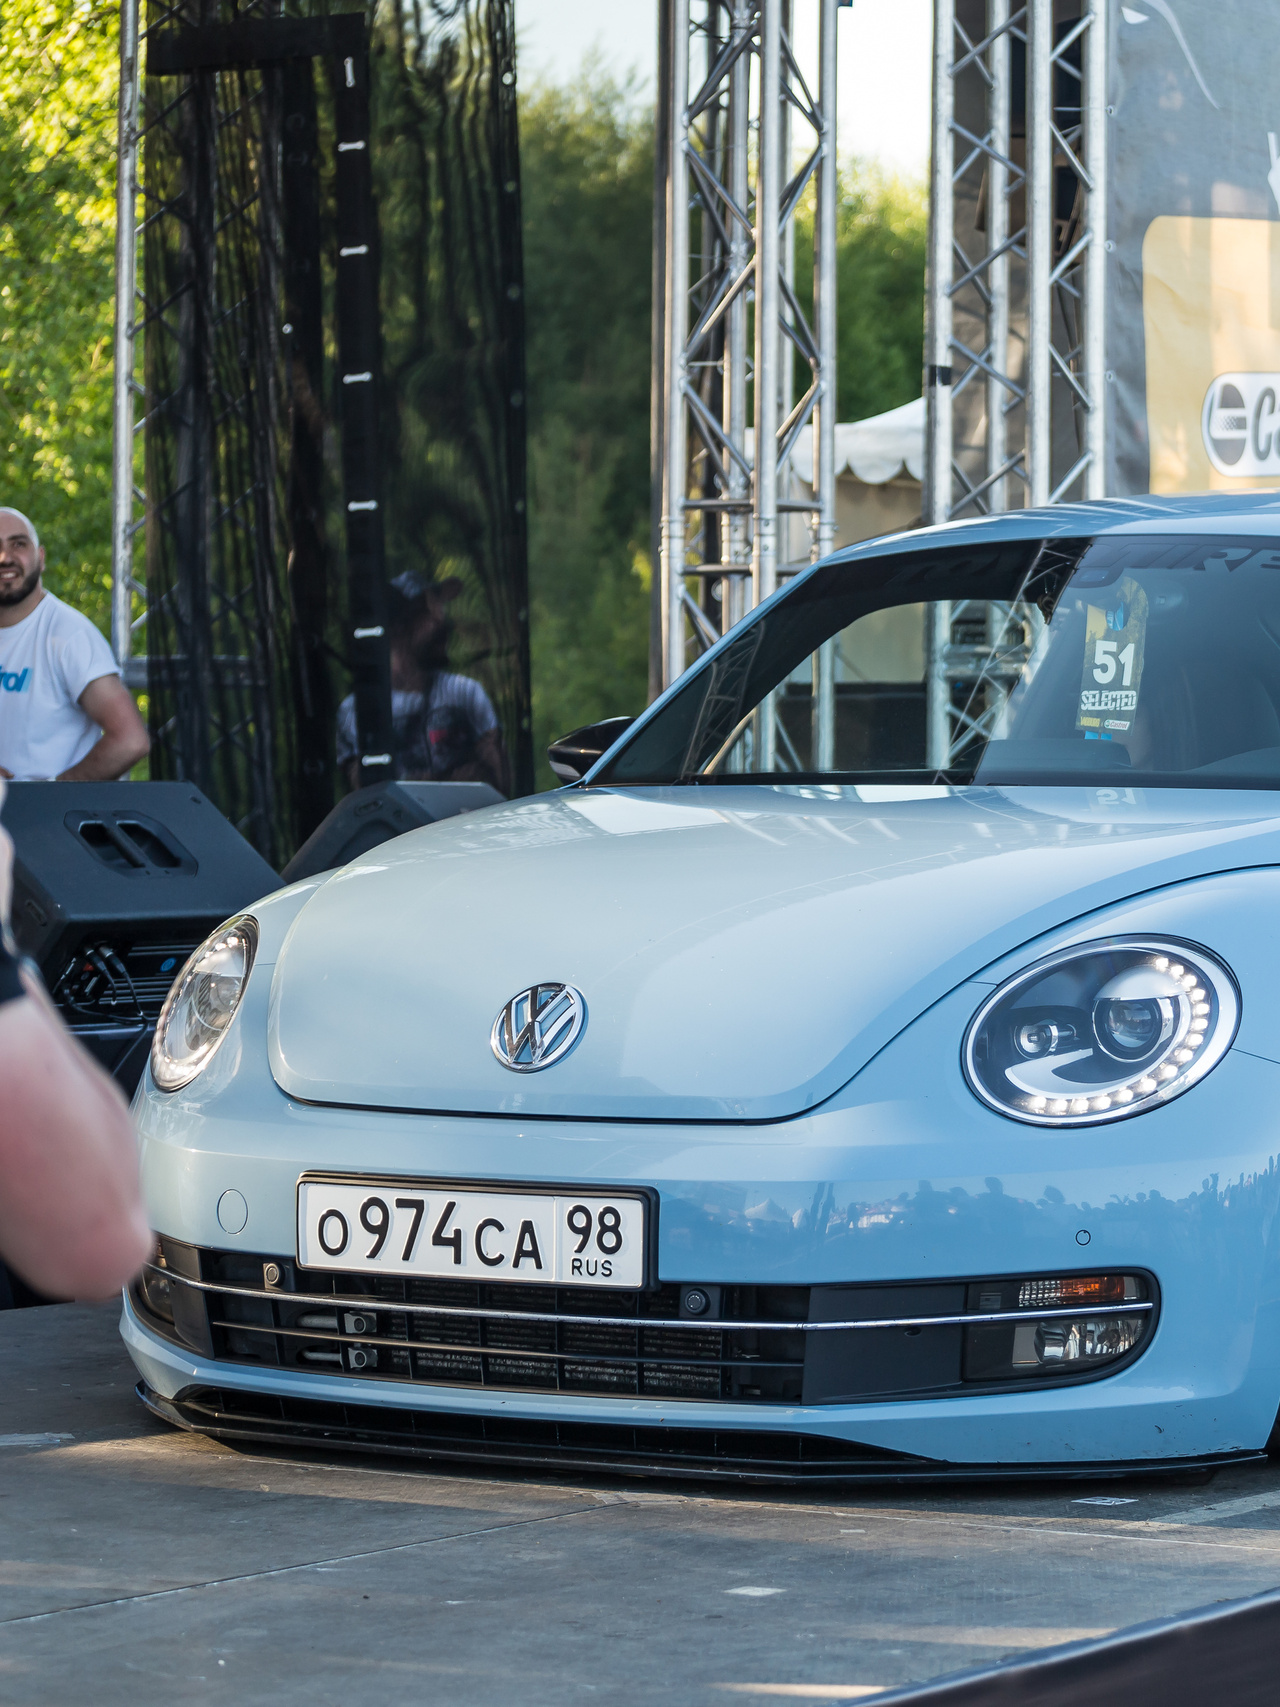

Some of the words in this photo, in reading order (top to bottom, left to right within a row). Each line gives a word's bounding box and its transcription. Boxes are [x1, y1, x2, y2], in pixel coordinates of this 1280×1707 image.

[1093, 640, 1135, 686] 51
[1080, 690, 1137, 711] SELECTED
[567, 1204, 623, 1254] 98
[571, 1258, 612, 1277] RUS
